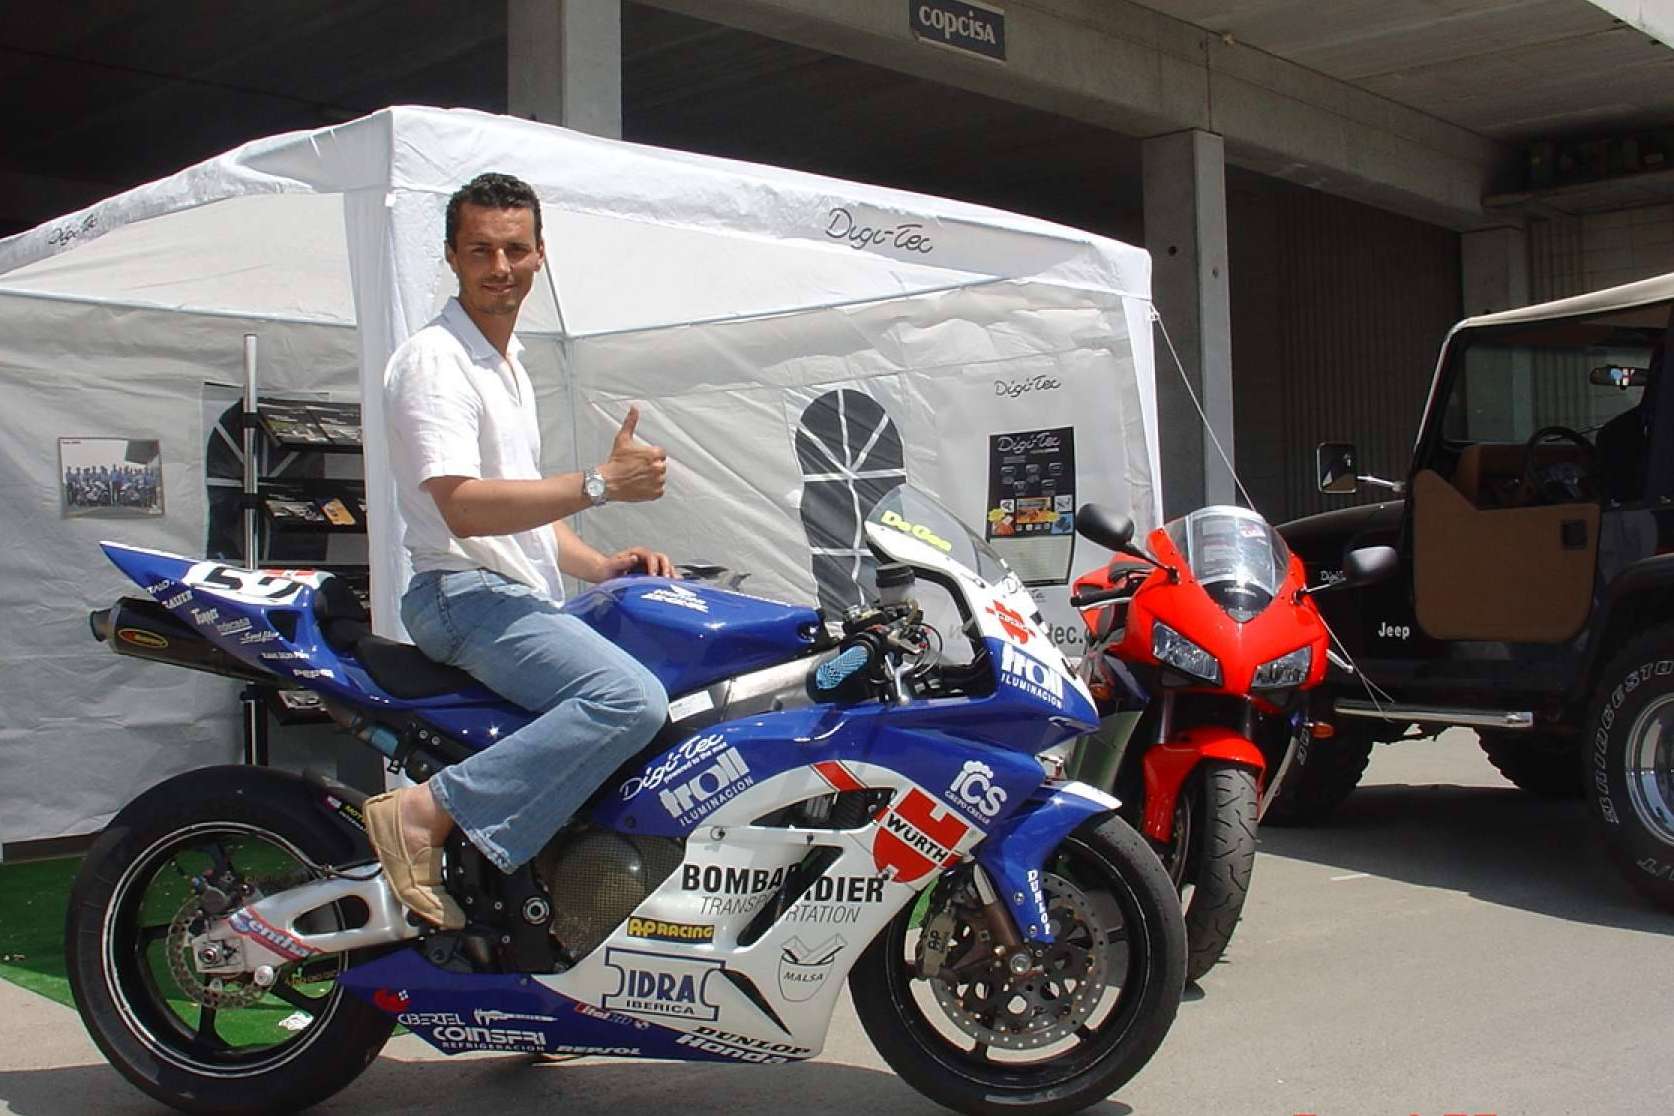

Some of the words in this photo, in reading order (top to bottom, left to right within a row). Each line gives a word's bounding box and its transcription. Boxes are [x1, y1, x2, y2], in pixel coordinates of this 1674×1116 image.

[825, 207, 933, 253] Digi-Tec
[994, 375, 1061, 398] Digi-Tec
[997, 432, 1060, 454] Digi-Tec
[1378, 621, 1410, 640] Jeep
[619, 734, 724, 801] Digi-Tec
[700, 895, 861, 924] TRANSPRTATION
[1027, 869, 1051, 935] DUNLOP
[628, 970, 697, 1003] IDRA
[626, 999, 695, 1014] IBERICA
[691, 1026, 811, 1054] DUNLOP
